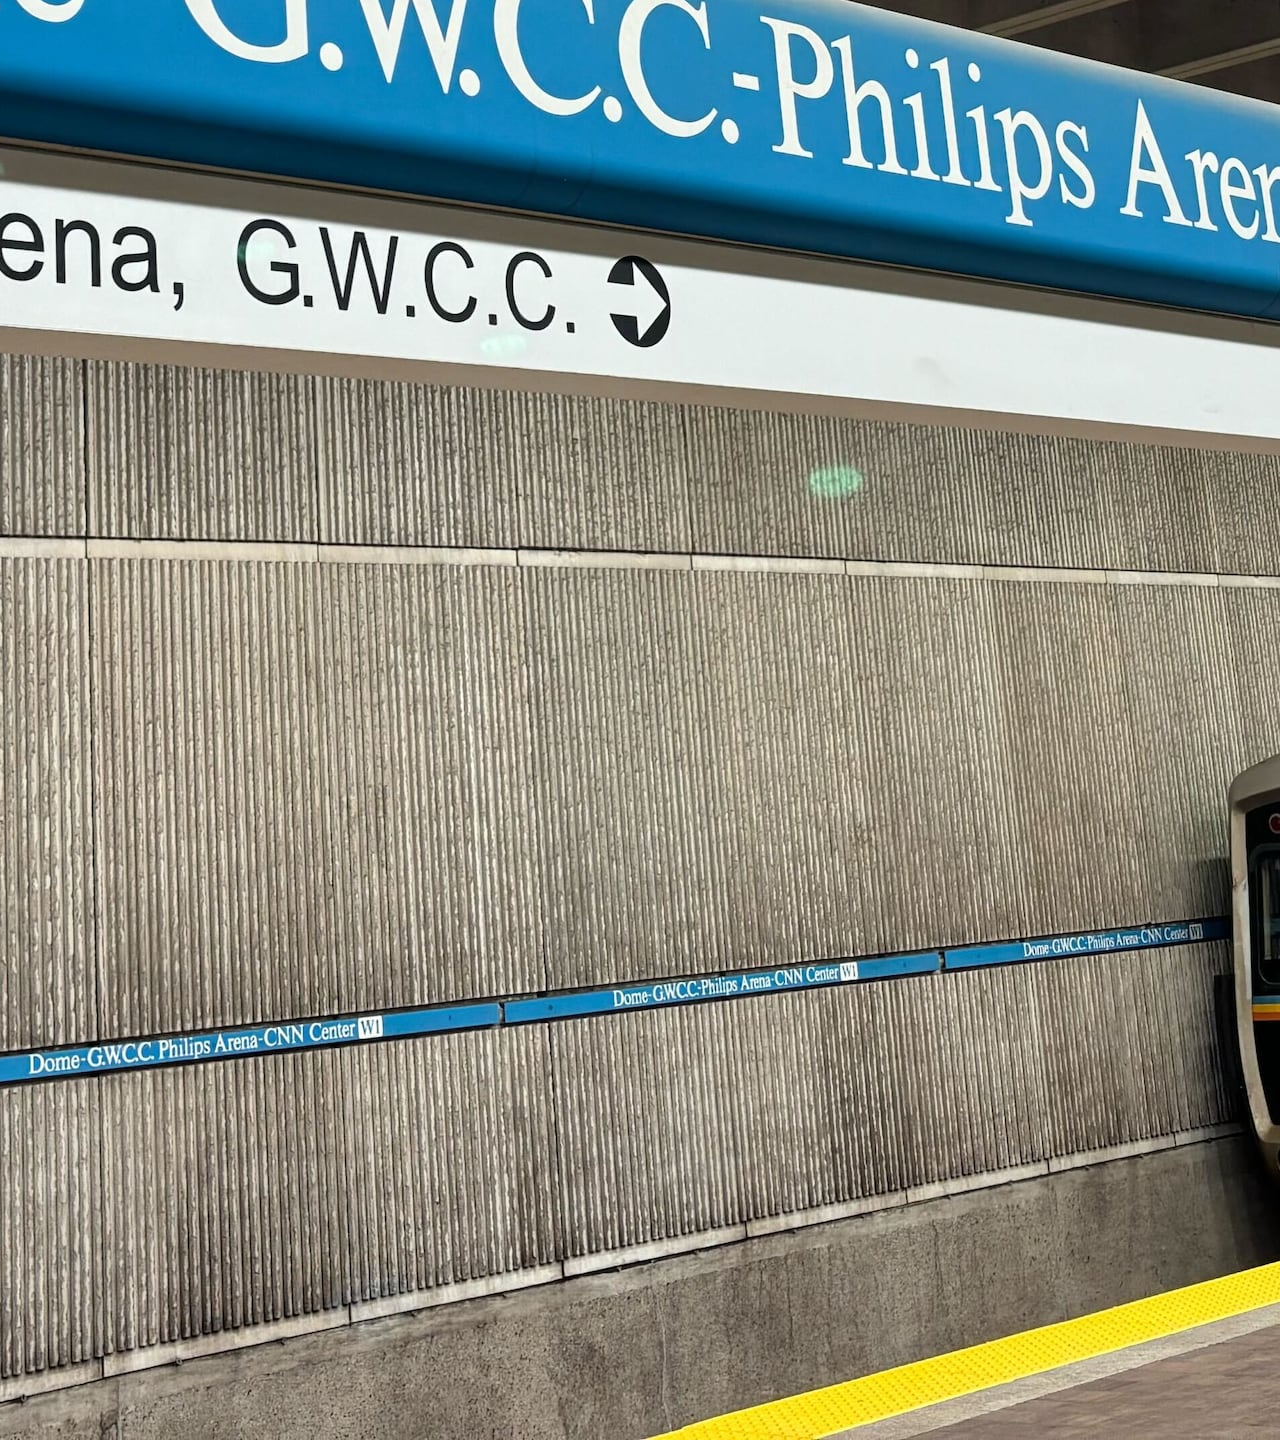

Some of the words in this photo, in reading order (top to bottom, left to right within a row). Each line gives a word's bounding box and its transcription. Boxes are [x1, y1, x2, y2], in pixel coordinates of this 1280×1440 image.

[237, 217, 577, 334] G.W.C.C.
[1164, 927, 1189, 941] Center
[741, 968, 803, 991] Arena-CNN
[806, 966, 839, 982] Center
[841, 962, 857, 980] W1
[158, 1036, 211, 1060] Philips
[215, 1024, 305, 1053] Arena-CNN
[309, 1022, 356, 1042] Center
[361, 1016, 380, 1036] W1
